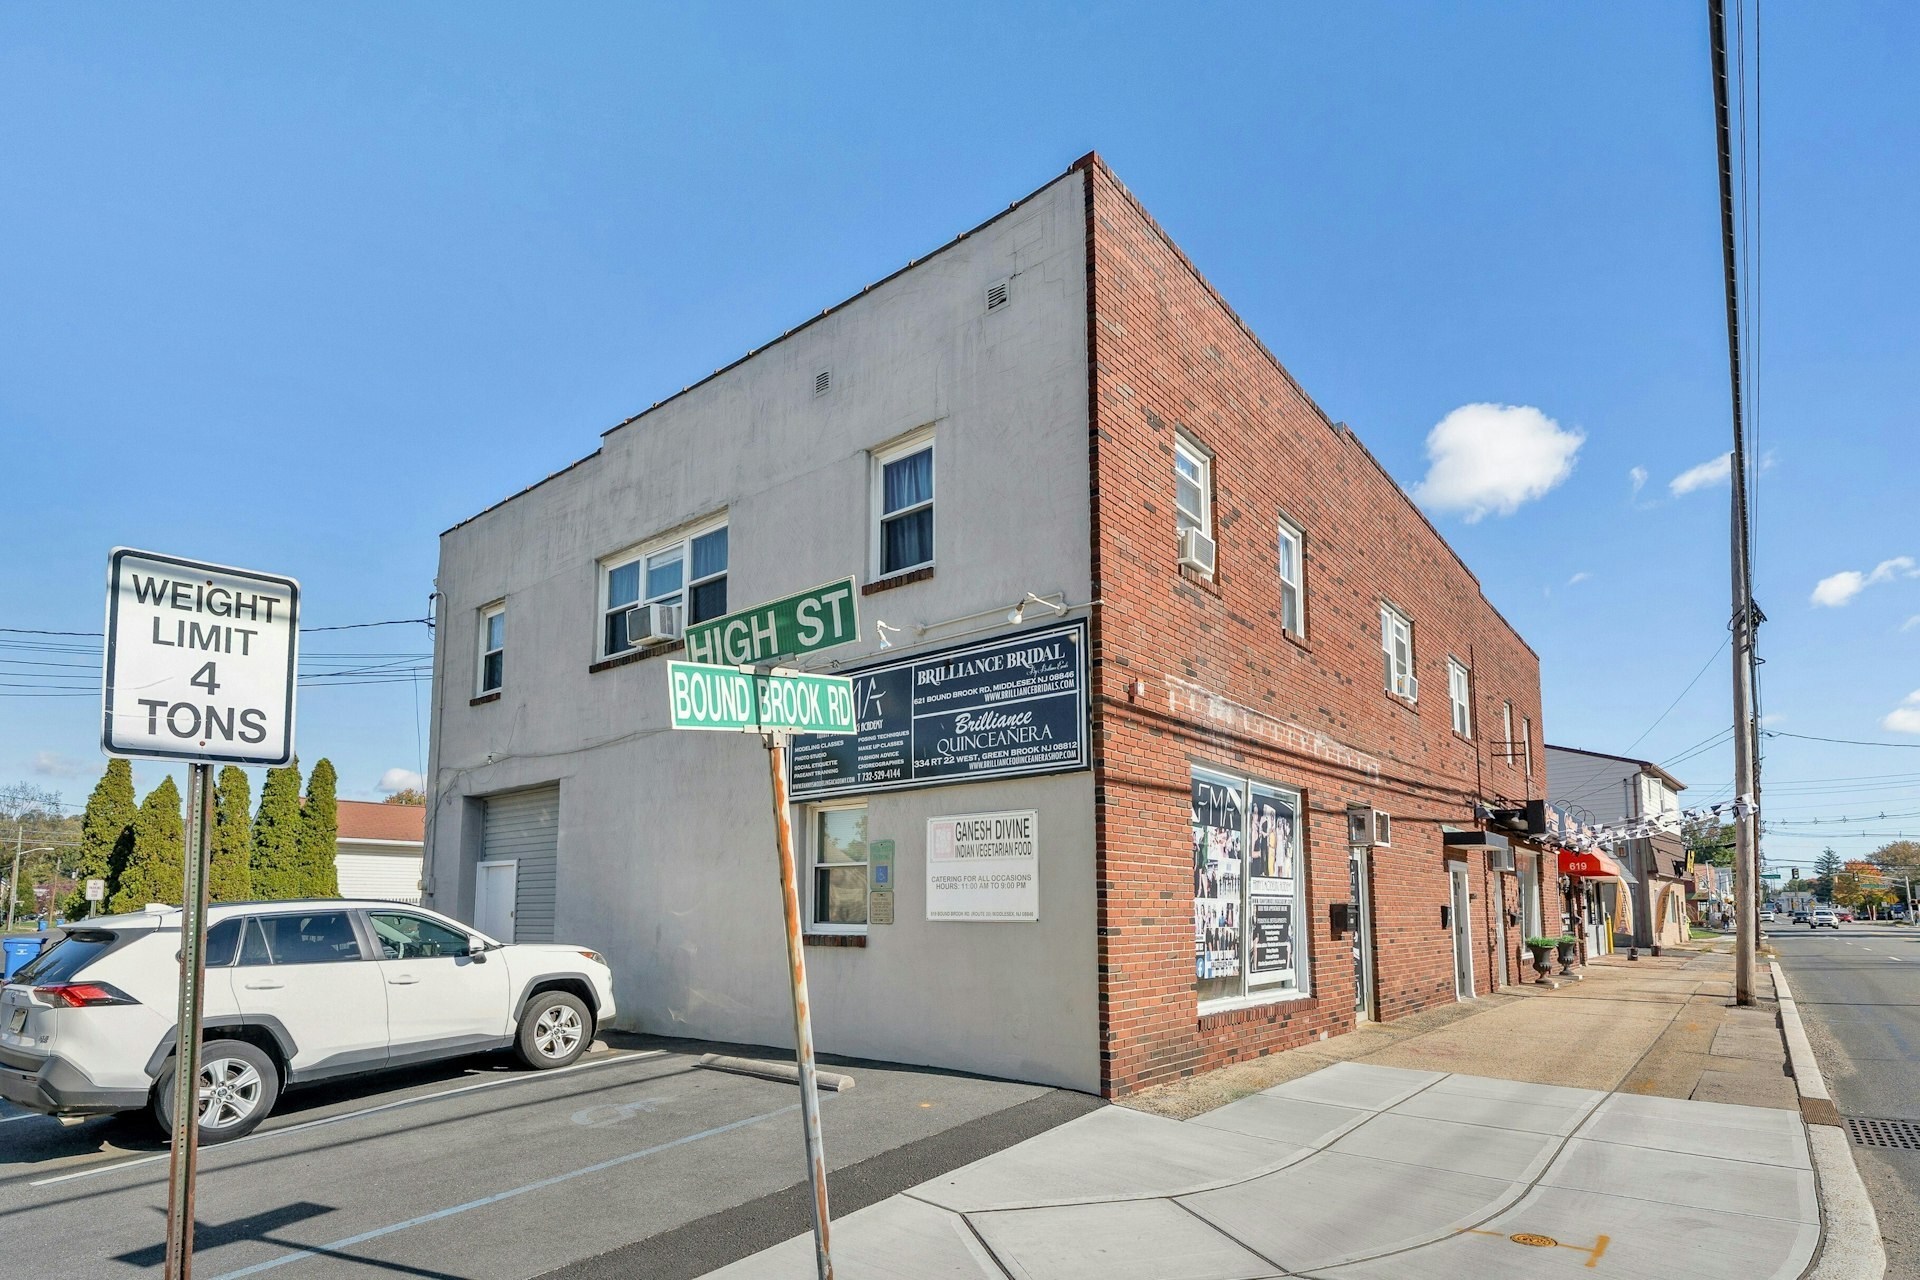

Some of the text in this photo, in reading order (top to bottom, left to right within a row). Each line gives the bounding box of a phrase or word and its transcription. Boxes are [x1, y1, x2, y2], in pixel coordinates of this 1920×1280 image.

[132, 574, 280, 623] WEIGHT
[152, 616, 258, 655] LIMIT
[689, 588, 848, 666] HIGH ST
[917, 655, 1004, 685] BRILLIANCE
[1006, 643, 1065, 668] BRIDAL
[190, 661, 220, 695] 4
[926, 692, 952, 703] BOUND
[952, 688, 978, 698] BROOK
[993, 677, 1037, 691] MIDDLESEX
[1037, 675, 1048, 683] NJ
[1049, 671, 1075, 681] 08846
[674, 671, 851, 726] BOUND BROOK RD
[984, 679, 1075, 703] WWW.BRILLIANCEBRIDALS.COM
[137, 698, 267, 743] TONS
[955, 710, 1032, 734] Brilliance
[794, 740, 844, 752] MODELING CLASSES
[877, 730, 910, 740] TECHNIQUES
[880, 740, 904, 748] CLASSES
[937, 723, 1053, 756] QUINCEAÑERA
[811, 760, 838, 768] ETIQUETTE
[858, 751, 899, 761] FASHION ADVICE
[858, 759, 904, 768] CHOREOGRAPHIES
[914, 741, 1077, 768] 334 RT 22 WEST, GREEN BROOK NJ 08812
[862, 769, 900, 782] 732-529-4144
[1198, 783, 1235, 829] FMA
[955, 818, 1030, 841] GANESH DIVINE
[955, 841, 1032, 858] INDIAN VEGETARIAN FOOD
[1569, 862, 1587, 870] 619
